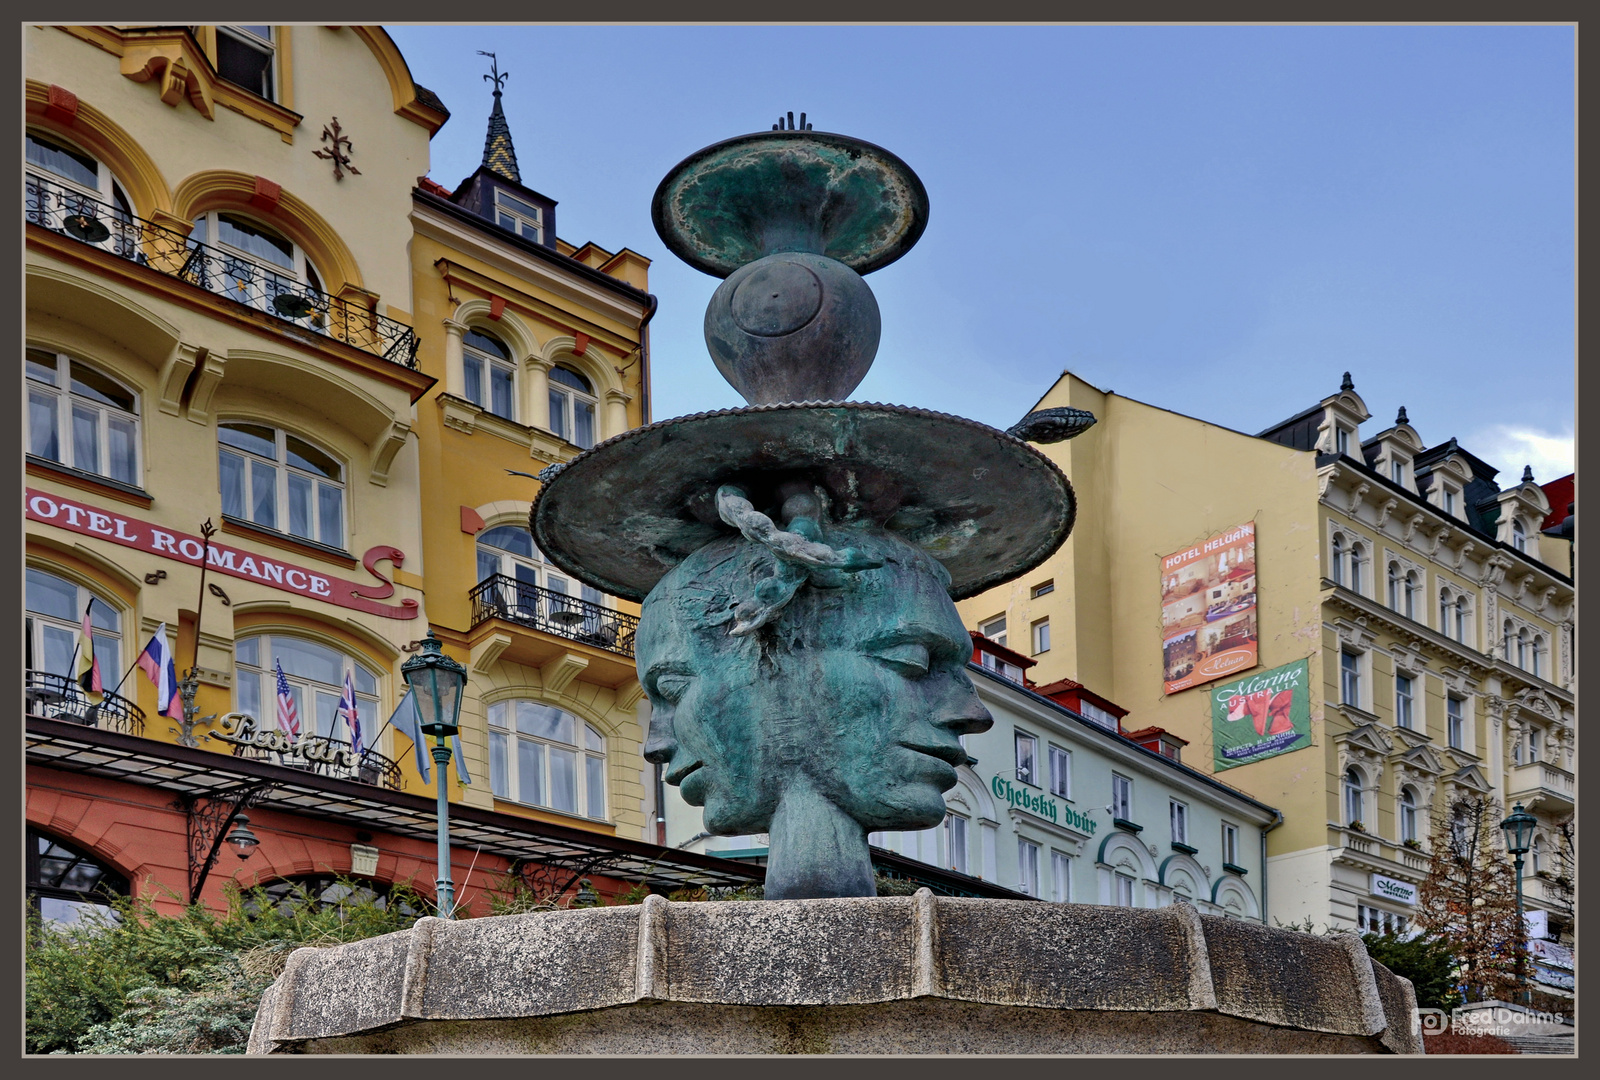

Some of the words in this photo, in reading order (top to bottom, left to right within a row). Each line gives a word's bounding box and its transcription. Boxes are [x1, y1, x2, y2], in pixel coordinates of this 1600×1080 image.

[26, 493, 137, 542] OTEL
[151, 529, 331, 597] ROMANCE
[1166, 548, 1201, 569] HOTEL
[1204, 526, 1251, 554] HELUAN
[1204, 655, 1245, 672] Heluan
[1217, 667, 1302, 702] Merino
[1220, 680, 1299, 710] AUSTRALIA
[992, 776, 1057, 824] Chebský
[1065, 804, 1097, 835] dvůr
[1377, 880, 1413, 897] Merino
